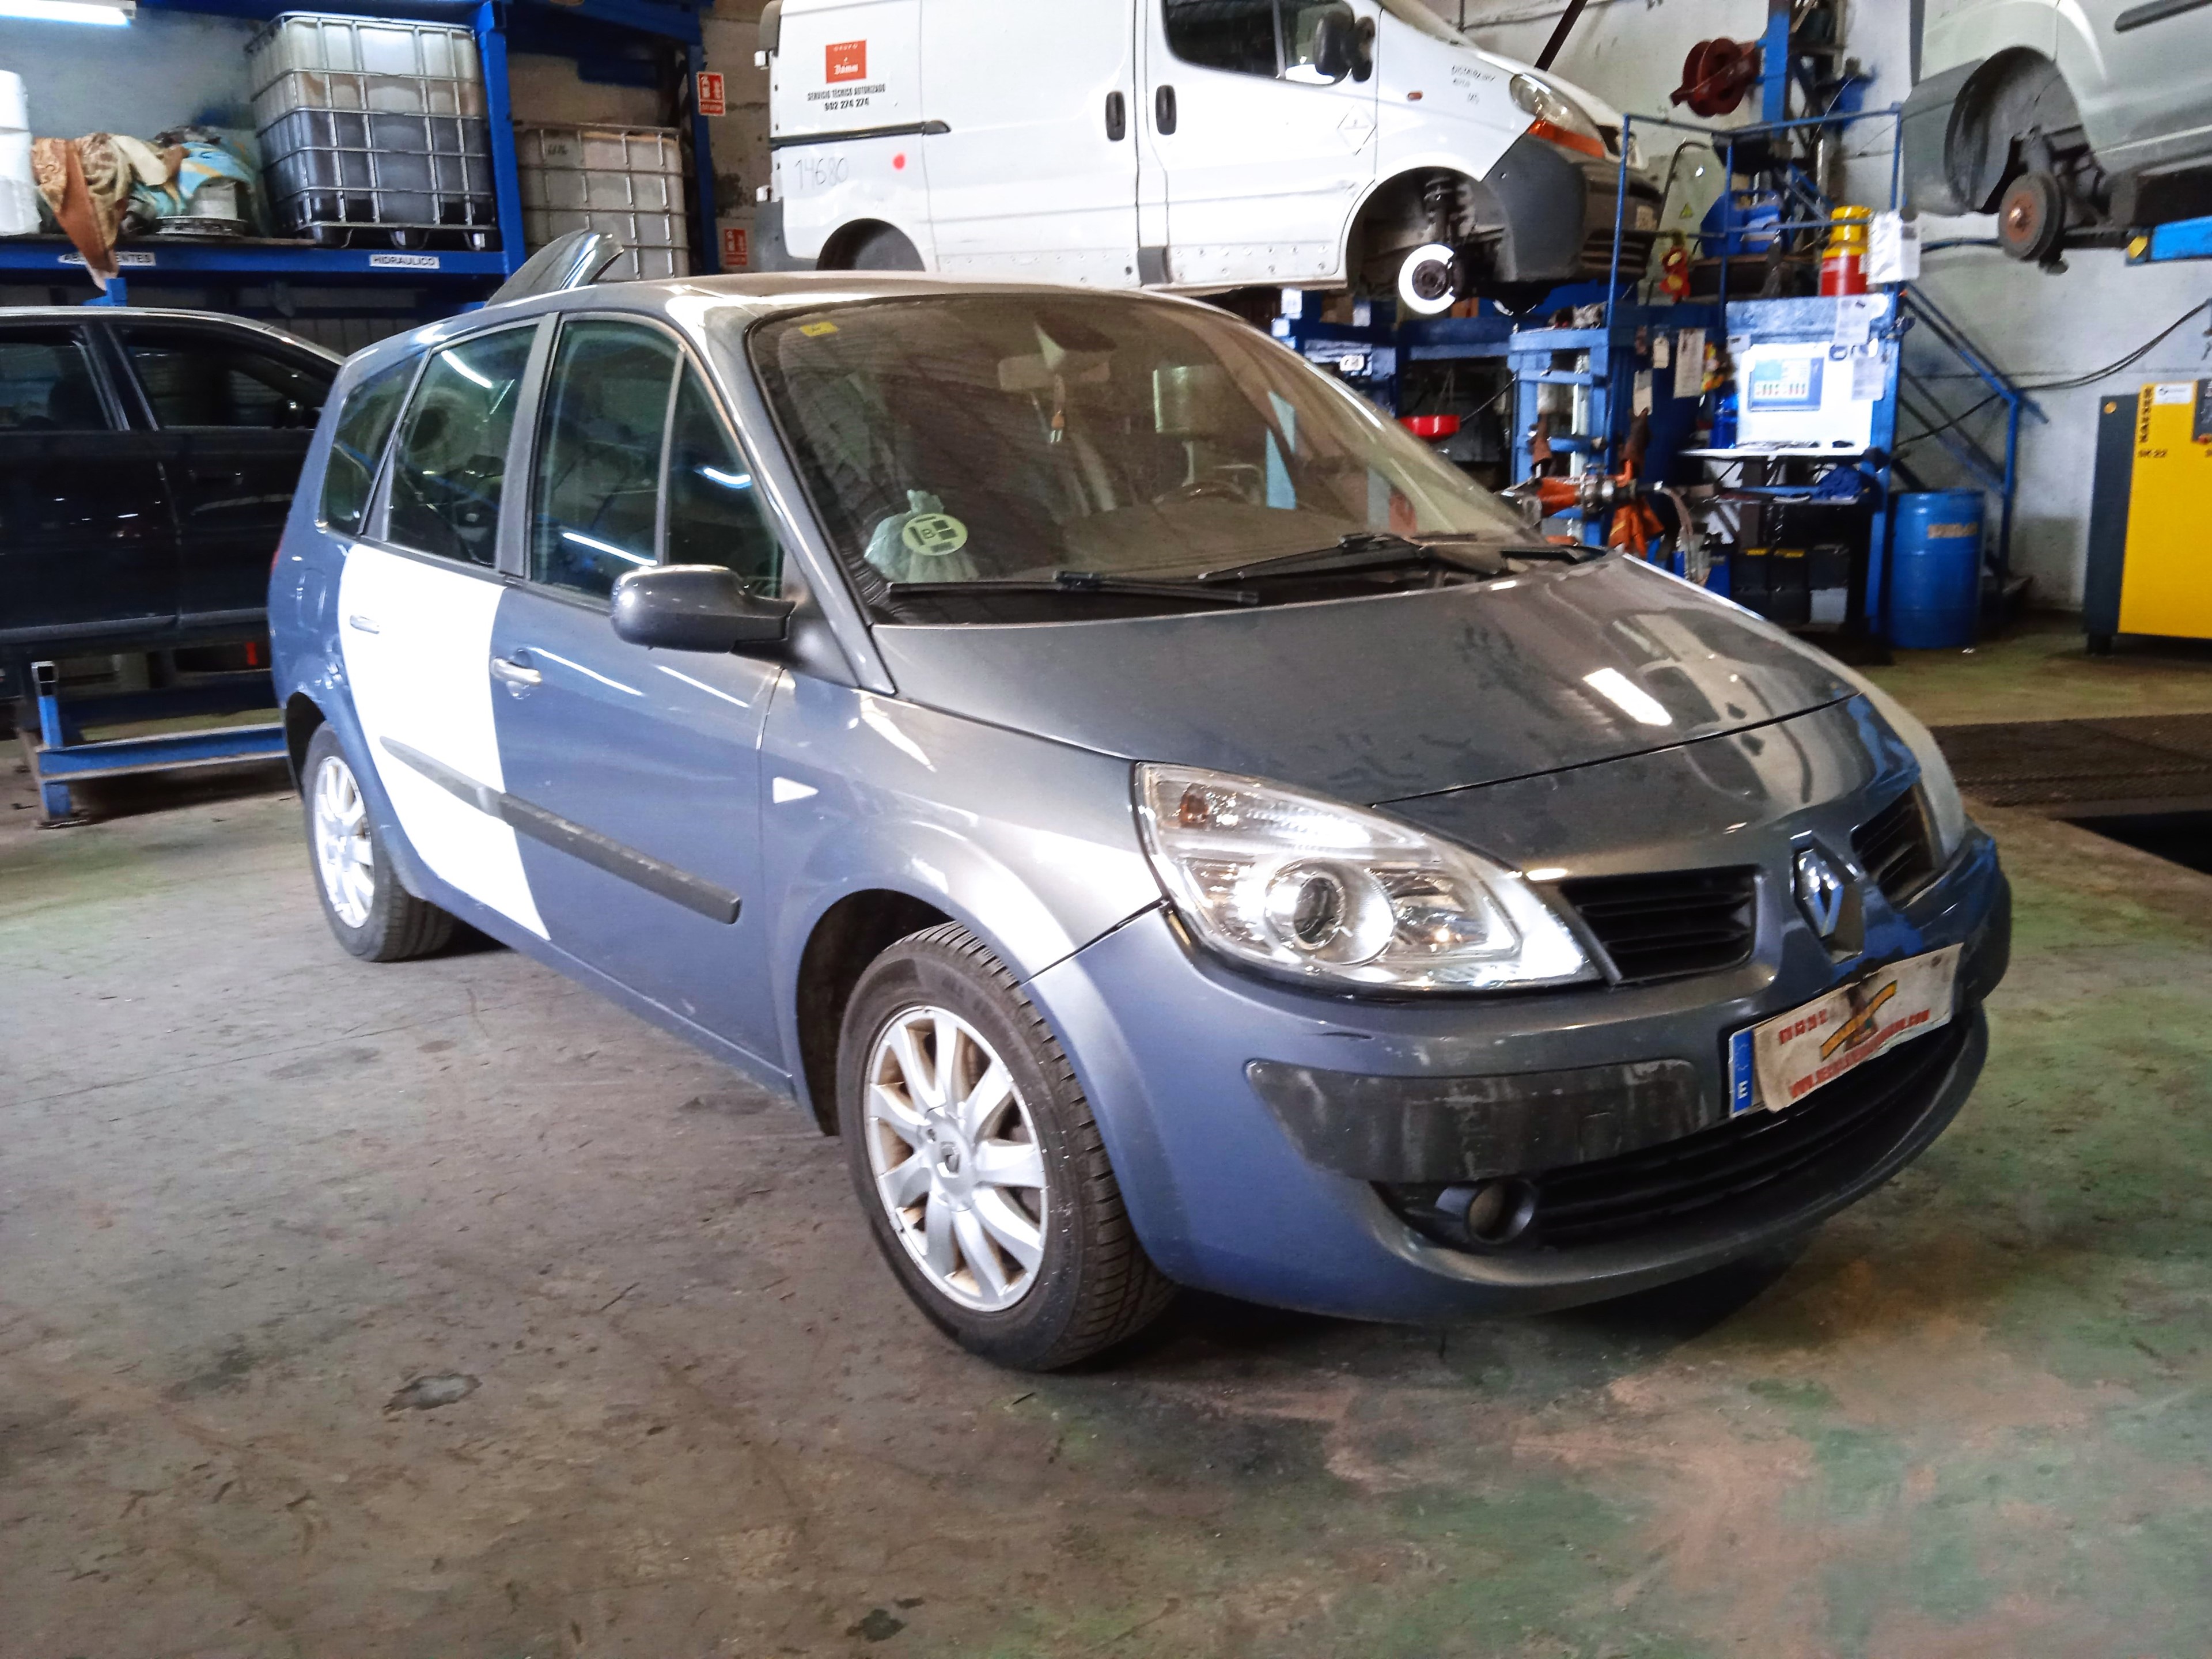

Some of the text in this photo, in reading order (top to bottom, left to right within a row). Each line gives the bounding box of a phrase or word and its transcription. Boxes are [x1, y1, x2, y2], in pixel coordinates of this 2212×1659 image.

[807, 90, 831, 101] SERVICIO
[854, 83, 886, 96] AUTORIZADO
[824, 97, 869, 111] 902 274 274
[794, 156, 849, 190] 14680
[921, 528, 936, 540] B
[1737, 1080, 1748, 1100] E
